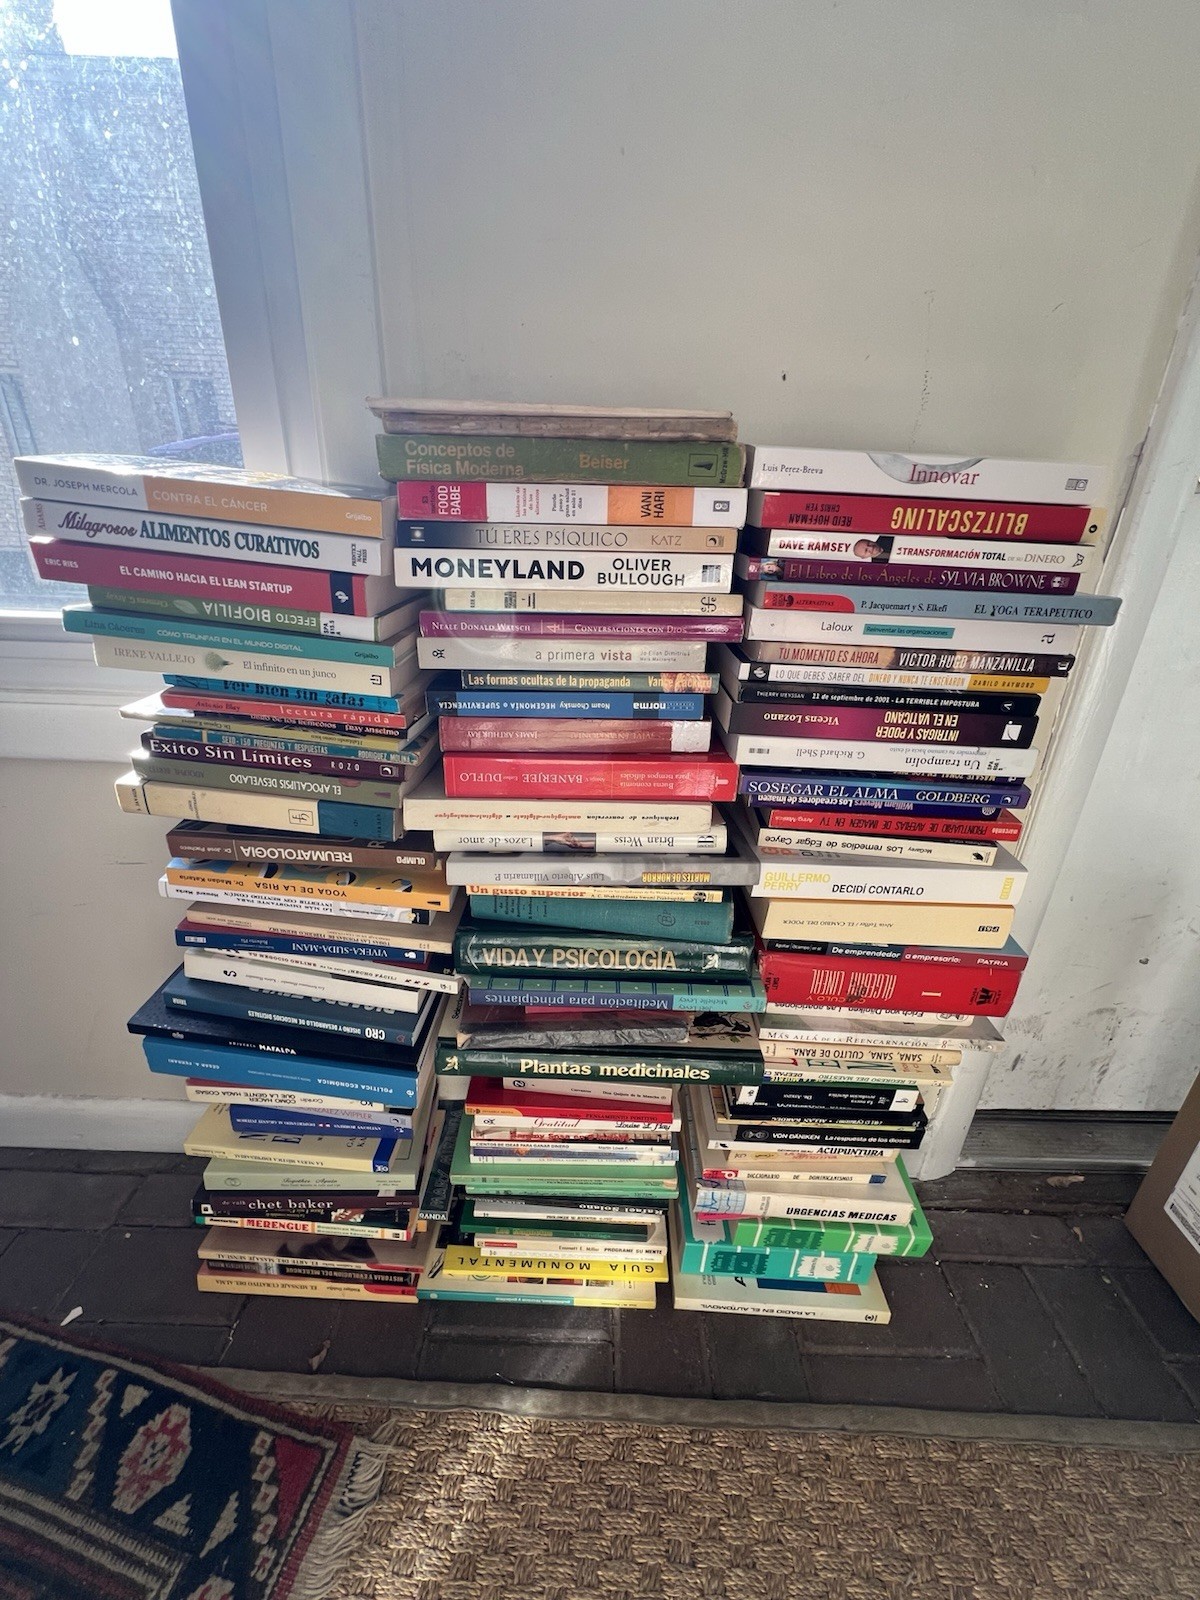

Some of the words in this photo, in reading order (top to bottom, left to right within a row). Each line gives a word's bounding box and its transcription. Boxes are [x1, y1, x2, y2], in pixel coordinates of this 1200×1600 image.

[404, 440, 492, 459] Conceptos
[495, 443, 515, 457] de
[406, 458, 452, 475] Física
[456, 460, 524, 476] Moderna
[579, 452, 630, 470] Beiser
[909, 464, 980, 485] Innovar
[34, 476, 51, 486] DR.
[54, 479, 90, 491] JOSEPH
[92, 483, 138, 496] MERCOLA
[438, 485, 449, 515] FOOD
[450, 485, 461, 515] BABE
[641, 491, 652, 518] VANI
[654, 491, 666, 518] HARI
[788, 514, 829, 526] HOFFMAN
[832, 515, 853, 527] REID
[890, 506, 1029, 535] BLITZSCALING
[778, 539, 805, 551] DAVE
[807, 541, 852, 553] RAMSEY
[44, 557, 62, 566] ERIC
[63, 559, 79, 569] RIES
[411, 557, 585, 580] MONEYLAND
[612, 558, 671, 572] OLIVER
[119, 565, 132, 576] EL
[133, 567, 174, 581] CAMINO
[176, 572, 207, 584] HACIA
[209, 576, 222, 586] EL
[222, 578, 248, 589] LEAN
[249, 580, 293, 594] STARTUP
[597, 572, 685, 587] BULLOUGH
[861, 601, 867, 609] P.
[868, 601, 910, 612] Jacquemart
[911, 603, 915, 612] y
[821, 622, 854, 632] Laloux
[114, 647, 146, 659] IRENE
[148, 650, 196, 665] VALLEJO
[633, 702, 667, 711] norma
[279, 705, 333, 718] lectura
[343, 713, 390, 724] rápida
[763, 712, 803, 724] Lozano
[804, 714, 840, 726] Vicens
[884, 711, 931, 725] VATICANO
[933, 713, 943, 726] EL
[943, 714, 959, 727] EN
[149, 739, 199, 756] Exito
[204, 746, 236, 761] Sin
[242, 749, 313, 769] Límites
[330, 760, 360, 772] ROZO
[905, 756, 960, 768] trampolín
[963, 759, 980, 770] Un
[229, 773, 278, 788] DESVELADO
[459, 772, 502, 782] DUFLO
[522, 774, 583, 784] BANERJEE
[280, 779, 330, 793] APOCALIPSIS
[332, 785, 342, 795] EL
[620, 781, 652, 789] economía
[655, 782, 674, 790] Buena
[748, 781, 824, 795] SOSEGAR
[828, 784, 850, 797] EL
[852, 786, 899, 800] ALMA
[915, 790, 991, 805] GOLDBERG
[458, 837, 486, 845] amor
[488, 837, 501, 847] de
[504, 837, 534, 848] Lazos
[614, 836, 643, 847] Weiss
[647, 836, 675, 847] Brian
[240, 845, 353, 863] REUMATOLOGIA
[396, 856, 426, 865] OLIMPO
[179, 875, 208, 883] Kataria
[764, 871, 831, 883] GUILLERMO
[254, 881, 280, 891] RISA
[283, 885, 296, 893] LA
[300, 886, 314, 894] DE
[470, 885, 489, 894] Un
[492, 887, 527, 896] gusto
[531, 889, 586, 898] superior
[763, 881, 802, 891] PERRY
[831, 883, 867, 894] DECIDÍ
[868, 885, 924, 897] CONTARLO
[318, 888, 347, 898] YOGA
[291, 942, 388, 958] VIVEKA-SUDA-MANI
[482, 948, 530, 967] VIDA
[532, 948, 547, 967] Y
[552, 948, 677, 970] PSICOLOGÍA
[977, 958, 1009, 966] PATRIA
[484, 994, 564, 1006] principiantes
[569, 997, 595, 1006] para
[600, 997, 669, 1010] Meditación
[364, 1027, 386, 1040] CRO
[768, 1031, 789, 1040] MÁS
[793, 1034, 817, 1042] ALLÁ
[520, 1059, 592, 1076] Plantas
[599, 1063, 711, 1080] medicinales
[316, 1078, 359, 1089] ECONÓMICA
[361, 1084, 394, 1094] POLÍTICA
[533, 1117, 581, 1129] Gratitud
[816, 1147, 884, 1157] ACUPUNTURA
[248, 1199, 283, 1210] chet
[288, 1198, 333, 1209] baker
[579, 1203, 620, 1212] Solano
[786, 1207, 846, 1218] URGENCIAS
[848, 1212, 898, 1221] MEDICAS
[246, 1219, 309, 1232] MERENGUE
[458, 1257, 591, 1270] MONUMENTAL
[609, 1264, 654, 1274] GUÍA
